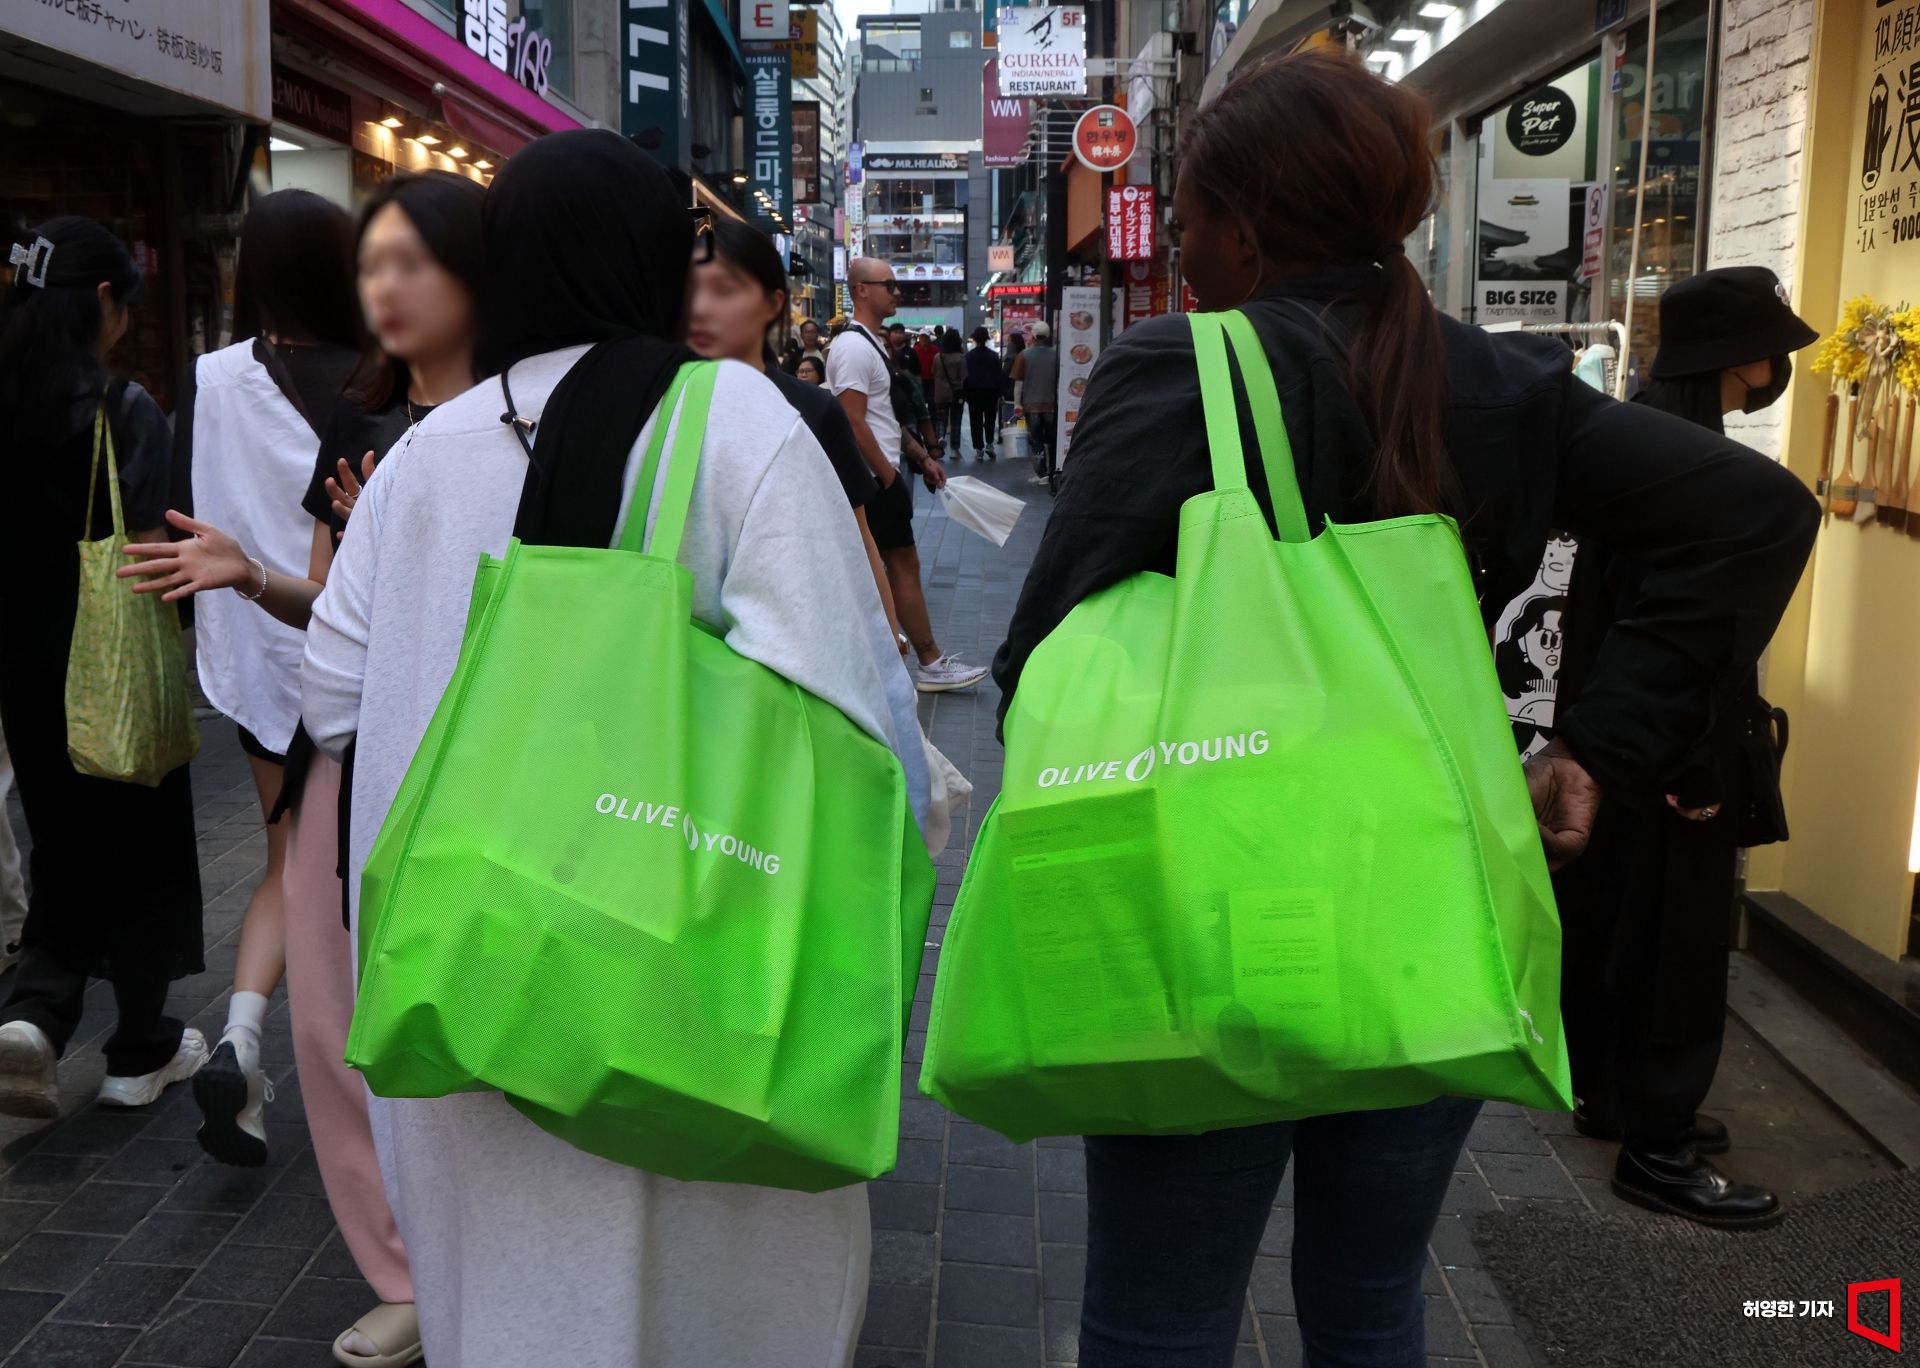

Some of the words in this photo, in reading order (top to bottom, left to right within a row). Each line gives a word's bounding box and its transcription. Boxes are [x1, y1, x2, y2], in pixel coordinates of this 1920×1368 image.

[1062, 12, 1080, 26] 5F
[629, 0, 669, 104] LL
[745, 55, 787, 64] MARSHALL
[1004, 53, 1079, 68] GURKHA
[1011, 69, 1073, 78] INDIAN/NEPALI
[1009, 81, 1076, 92] RESTAURANT
[991, 99, 1022, 117] WM
[1521, 100, 1561, 118] Super
[1521, 115, 1560, 135] Pet
[985, 155, 1010, 163] fashion
[1138, 191, 1153, 201] 2F
[1486, 290, 1516, 305] BIG
[1037, 760, 1122, 788] OLIVE
[1159, 730, 1269, 765] YOUNG
[595, 793, 681, 828] OLIVE
[703, 832, 781, 876] YOUNG
